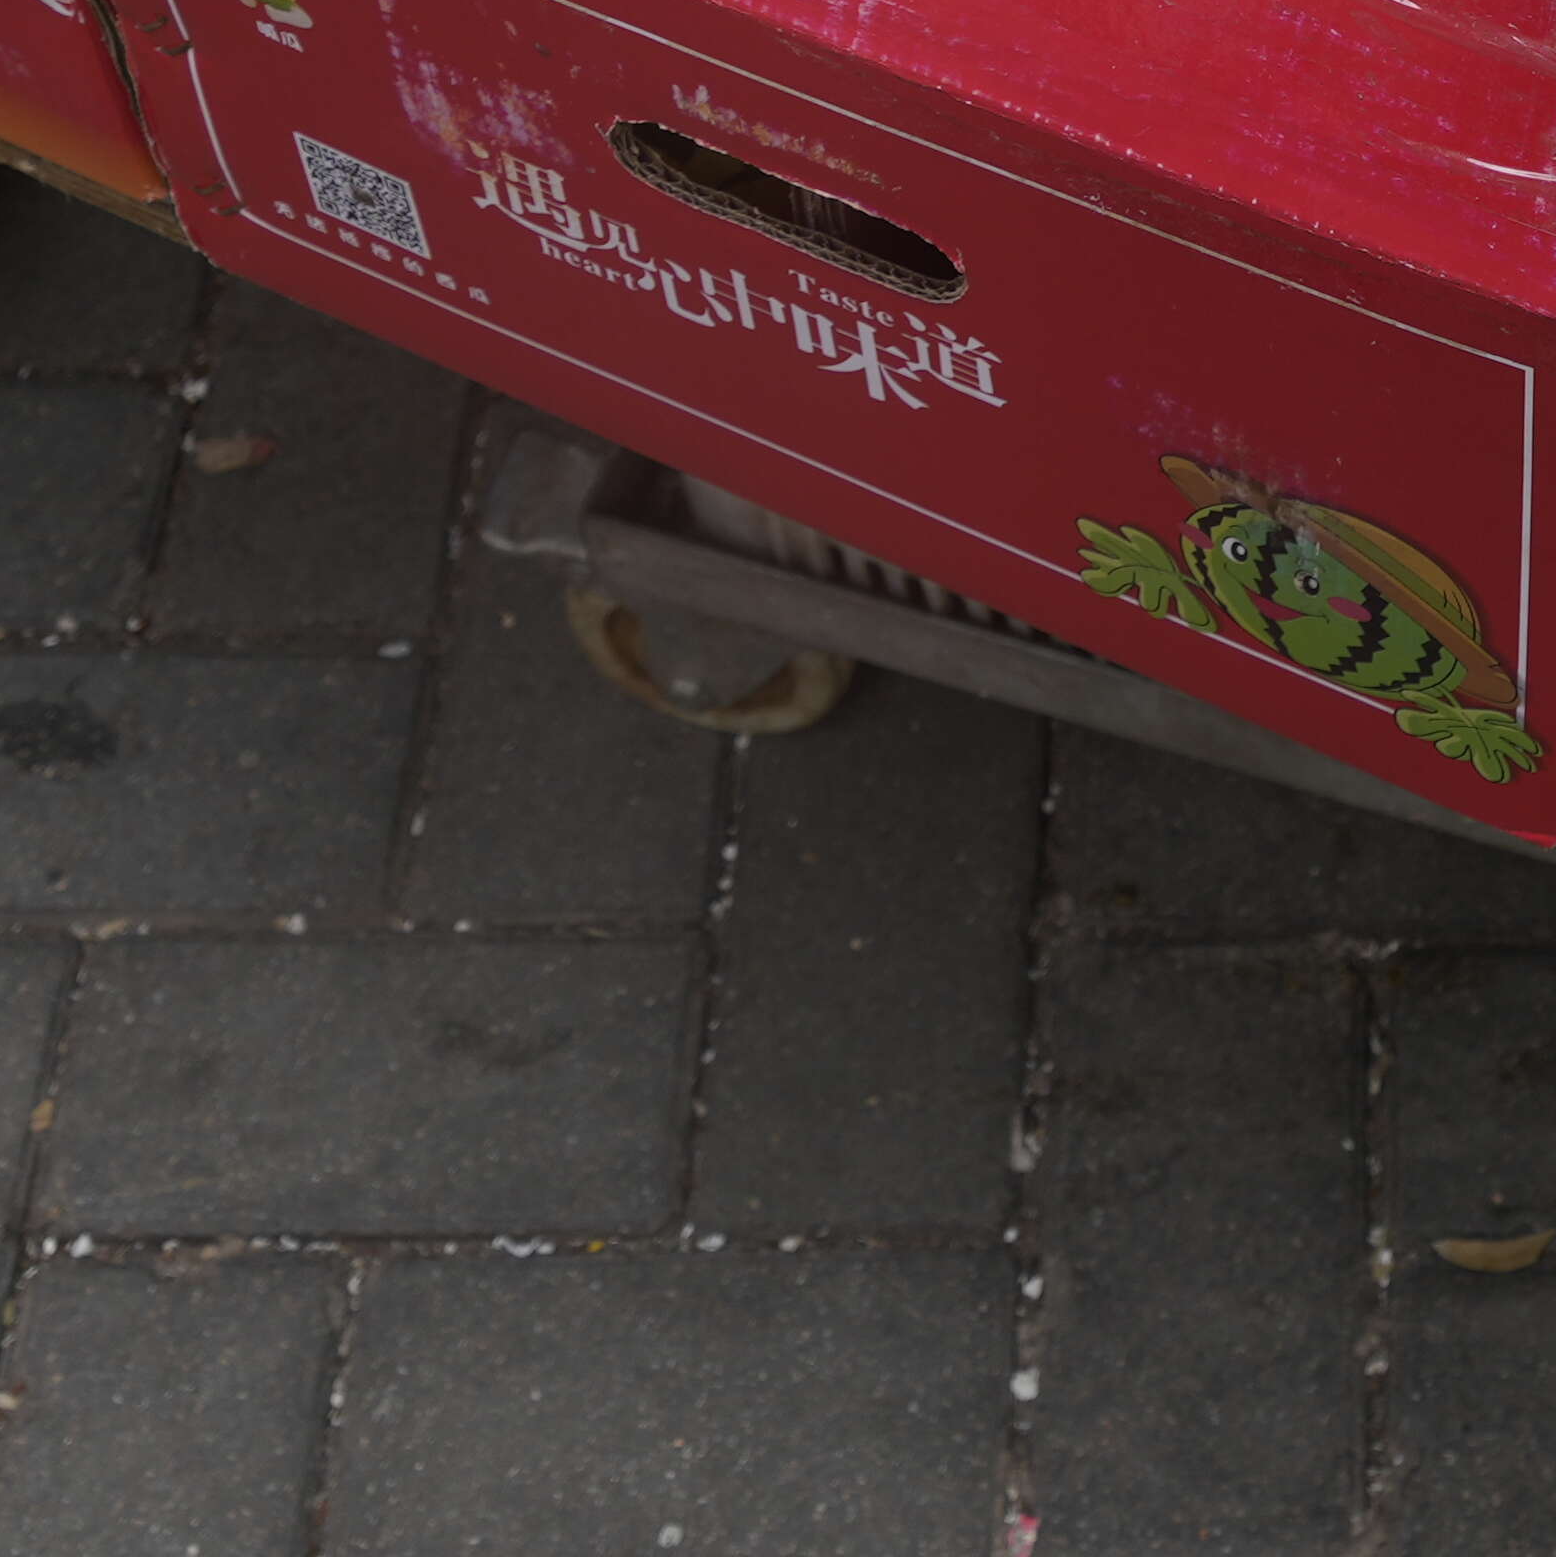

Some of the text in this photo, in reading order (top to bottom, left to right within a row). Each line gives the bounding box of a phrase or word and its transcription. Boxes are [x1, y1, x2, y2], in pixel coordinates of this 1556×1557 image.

[464, 138, 1009, 412] 遇见心中味道
[540, 234, 640, 293] heart
[788, 268, 896, 329] Taste
